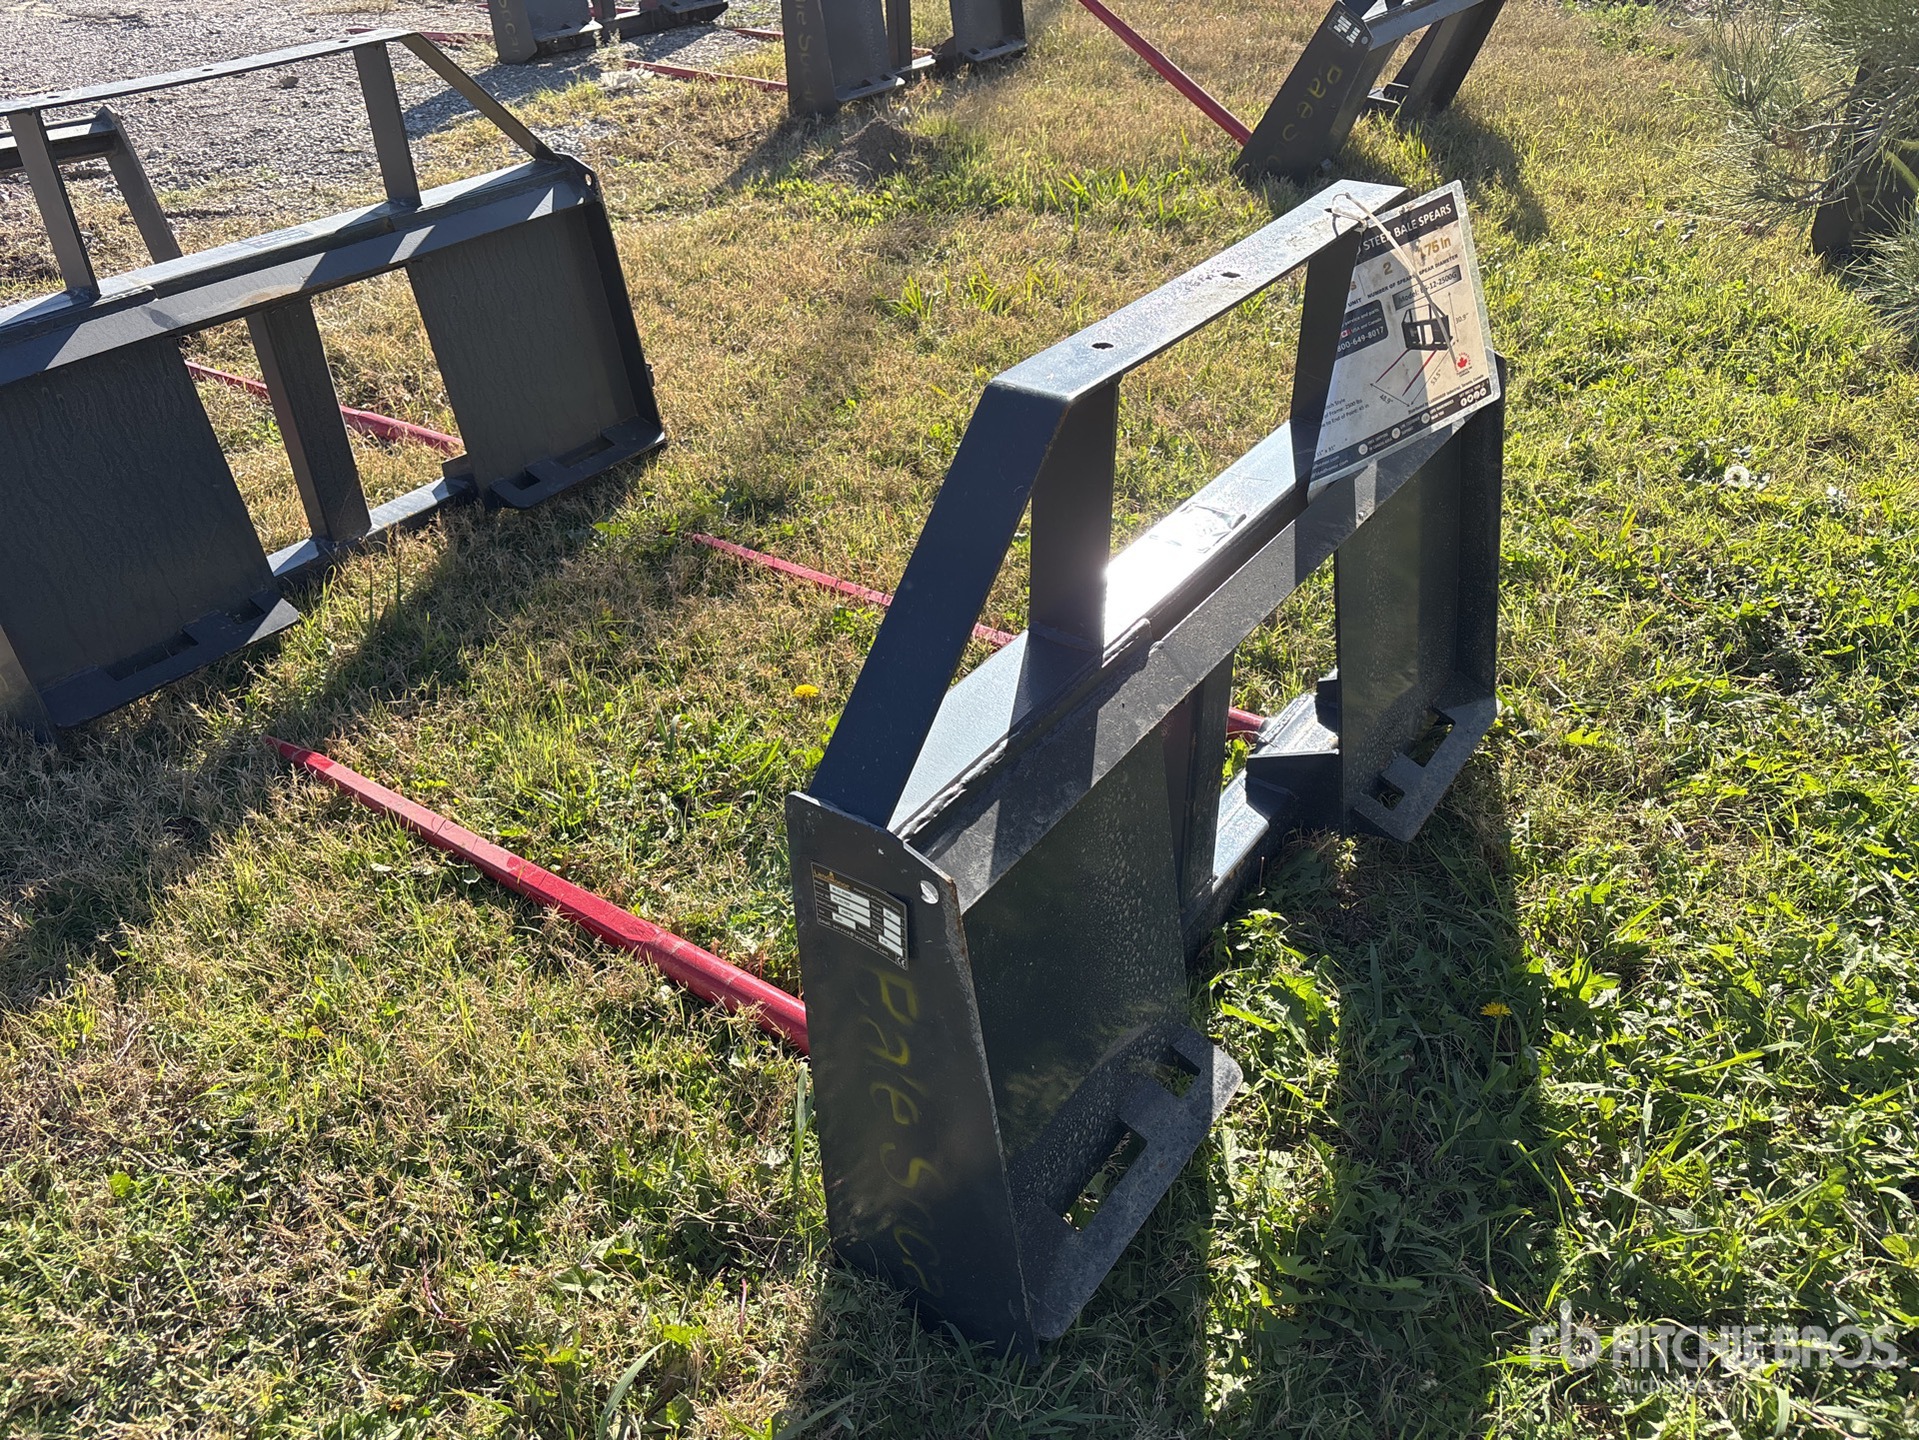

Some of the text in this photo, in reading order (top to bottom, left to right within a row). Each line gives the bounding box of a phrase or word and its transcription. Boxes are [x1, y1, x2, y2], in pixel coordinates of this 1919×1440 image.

[1393, 219, 1418, 237] BALE
[1418, 203, 1452, 227] SPEARS
[1382, 261, 1393, 275] 2
[1418, 253, 1458, 276] SPEAR DIAMETER
[1367, 284, 1389, 299] NUMBER
[1389, 281, 1396, 289] OF
